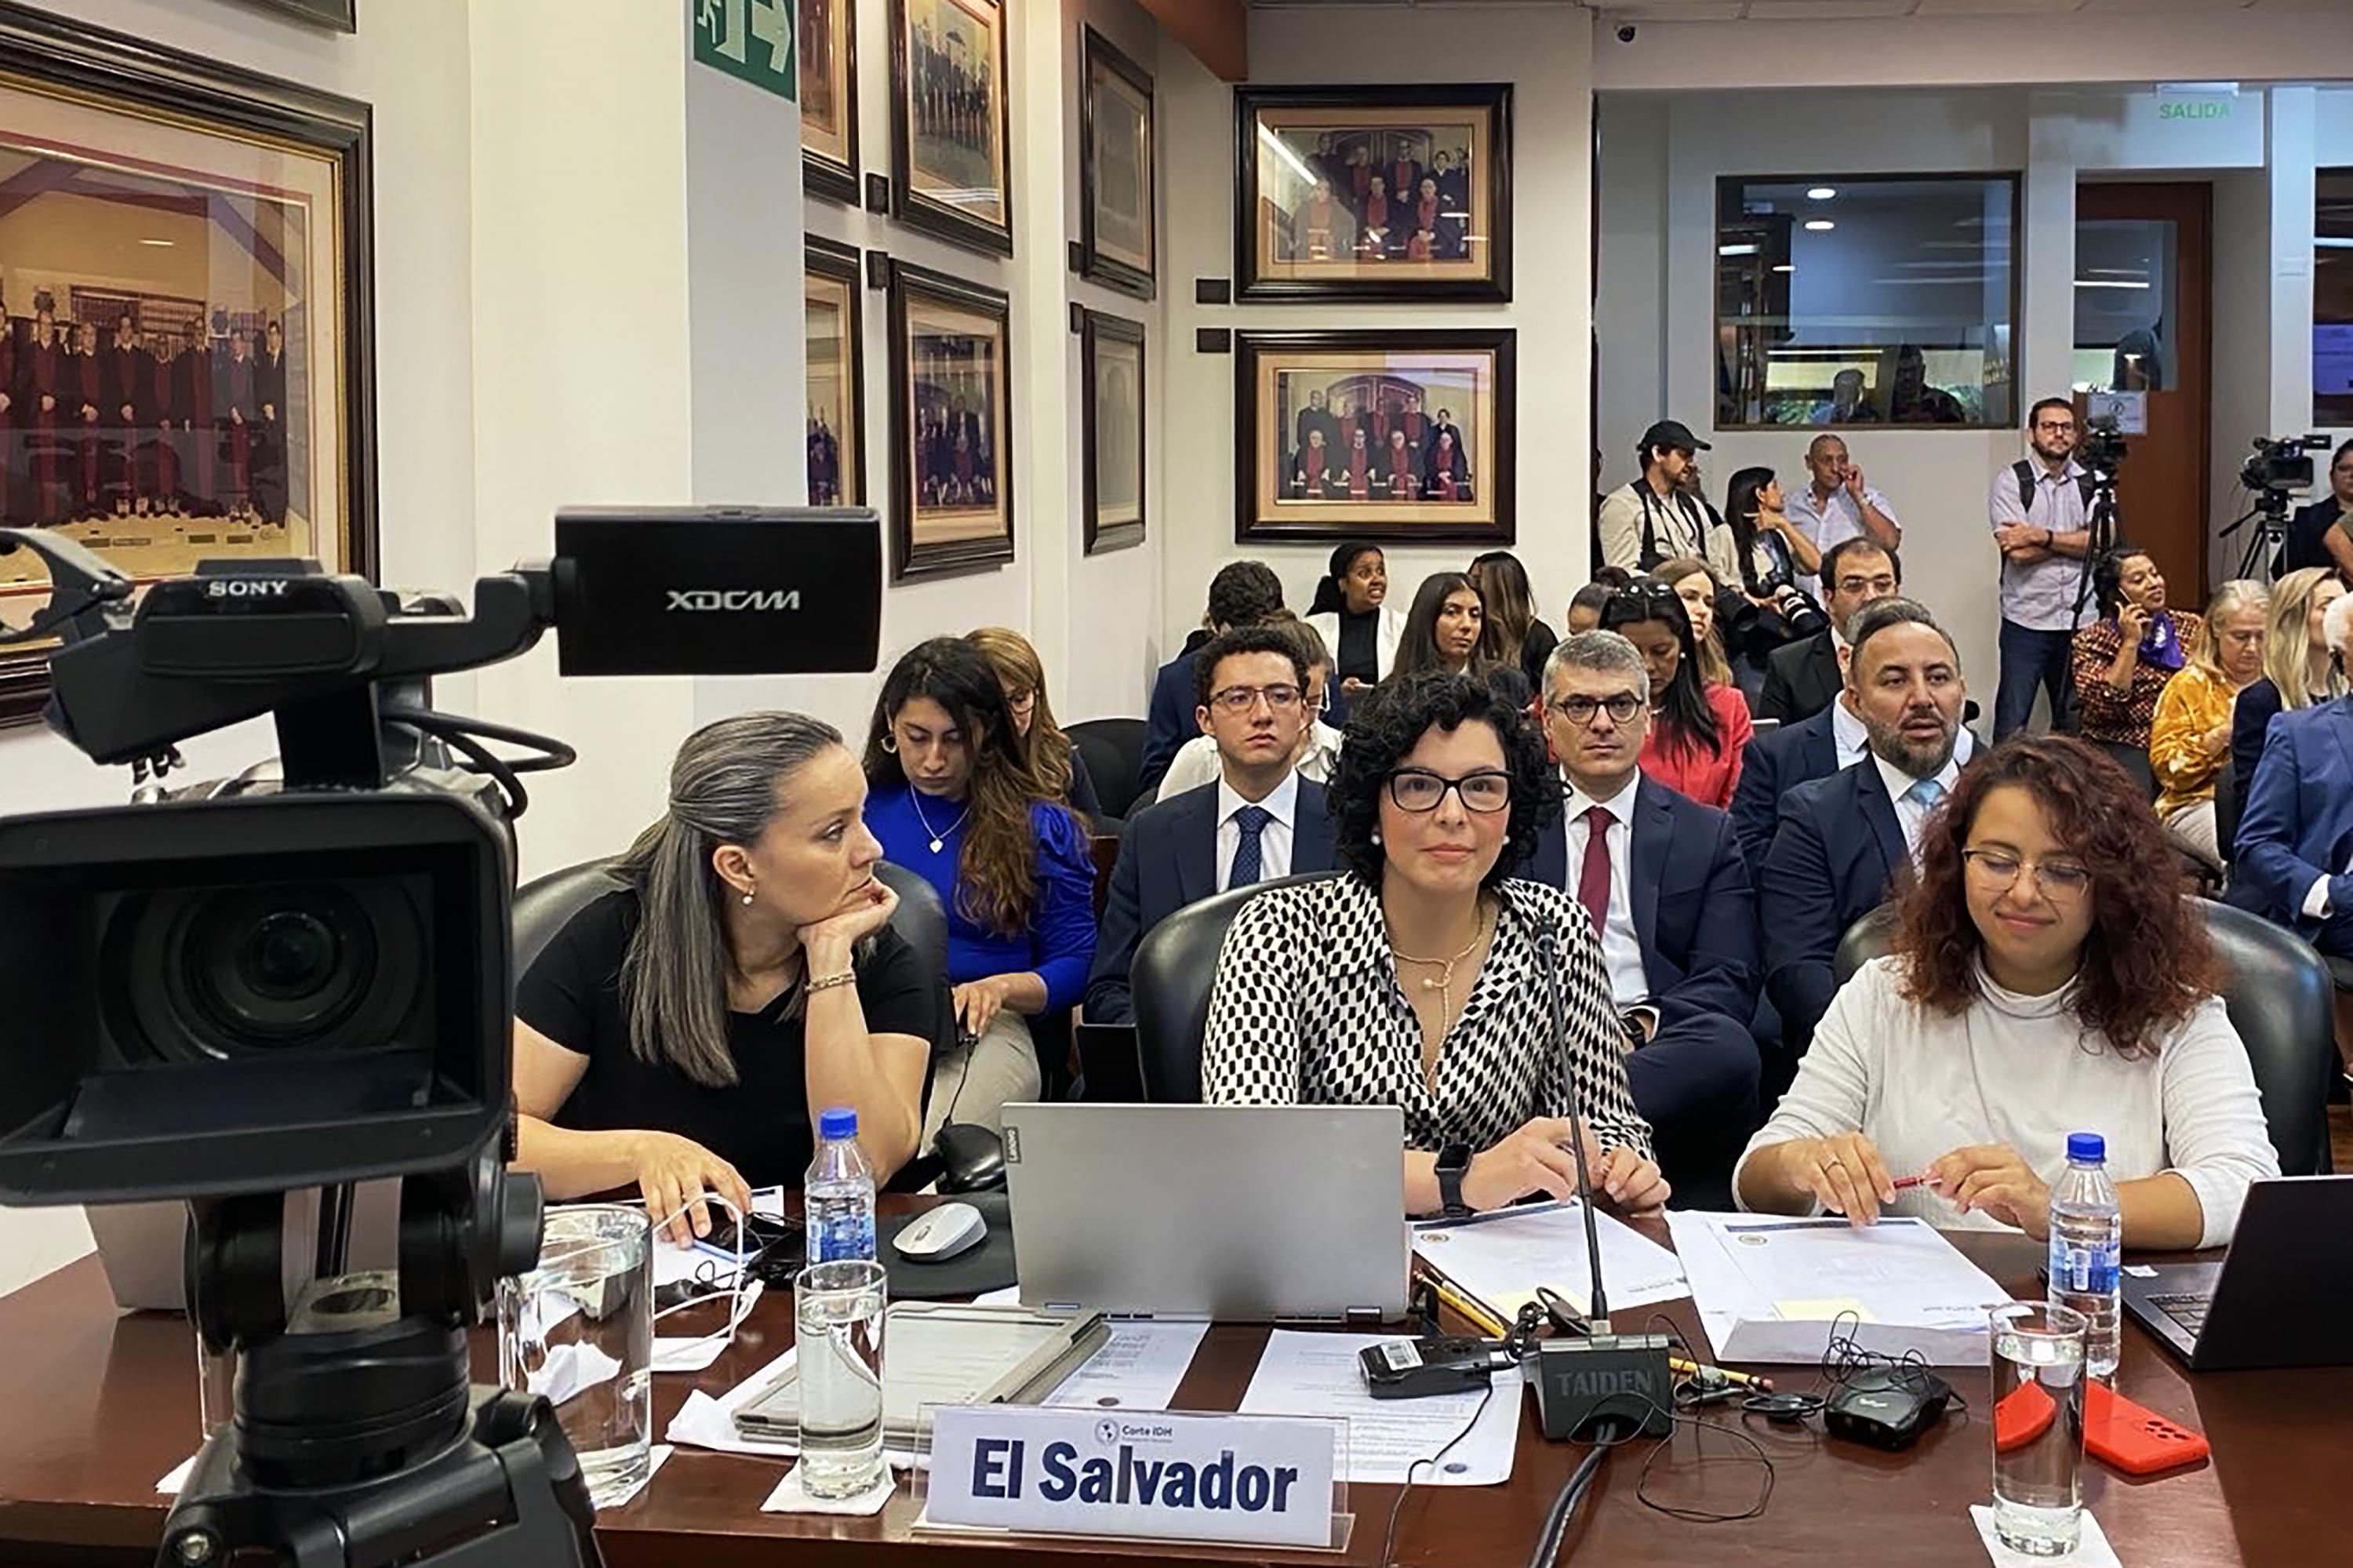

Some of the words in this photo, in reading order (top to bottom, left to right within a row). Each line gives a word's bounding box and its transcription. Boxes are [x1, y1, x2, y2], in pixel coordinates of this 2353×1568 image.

[2159, 103, 2232, 119] SALIDA
[209, 581, 287, 596] SONY
[667, 591, 799, 610] XDCAM
[1555, 1370, 1653, 1397] TAIDEN
[1122, 1424, 1151, 1435] Corte
[1152, 1427, 1173, 1437] IDH
[972, 1438, 1024, 1499] El
[1038, 1441, 1298, 1512] Salvador
